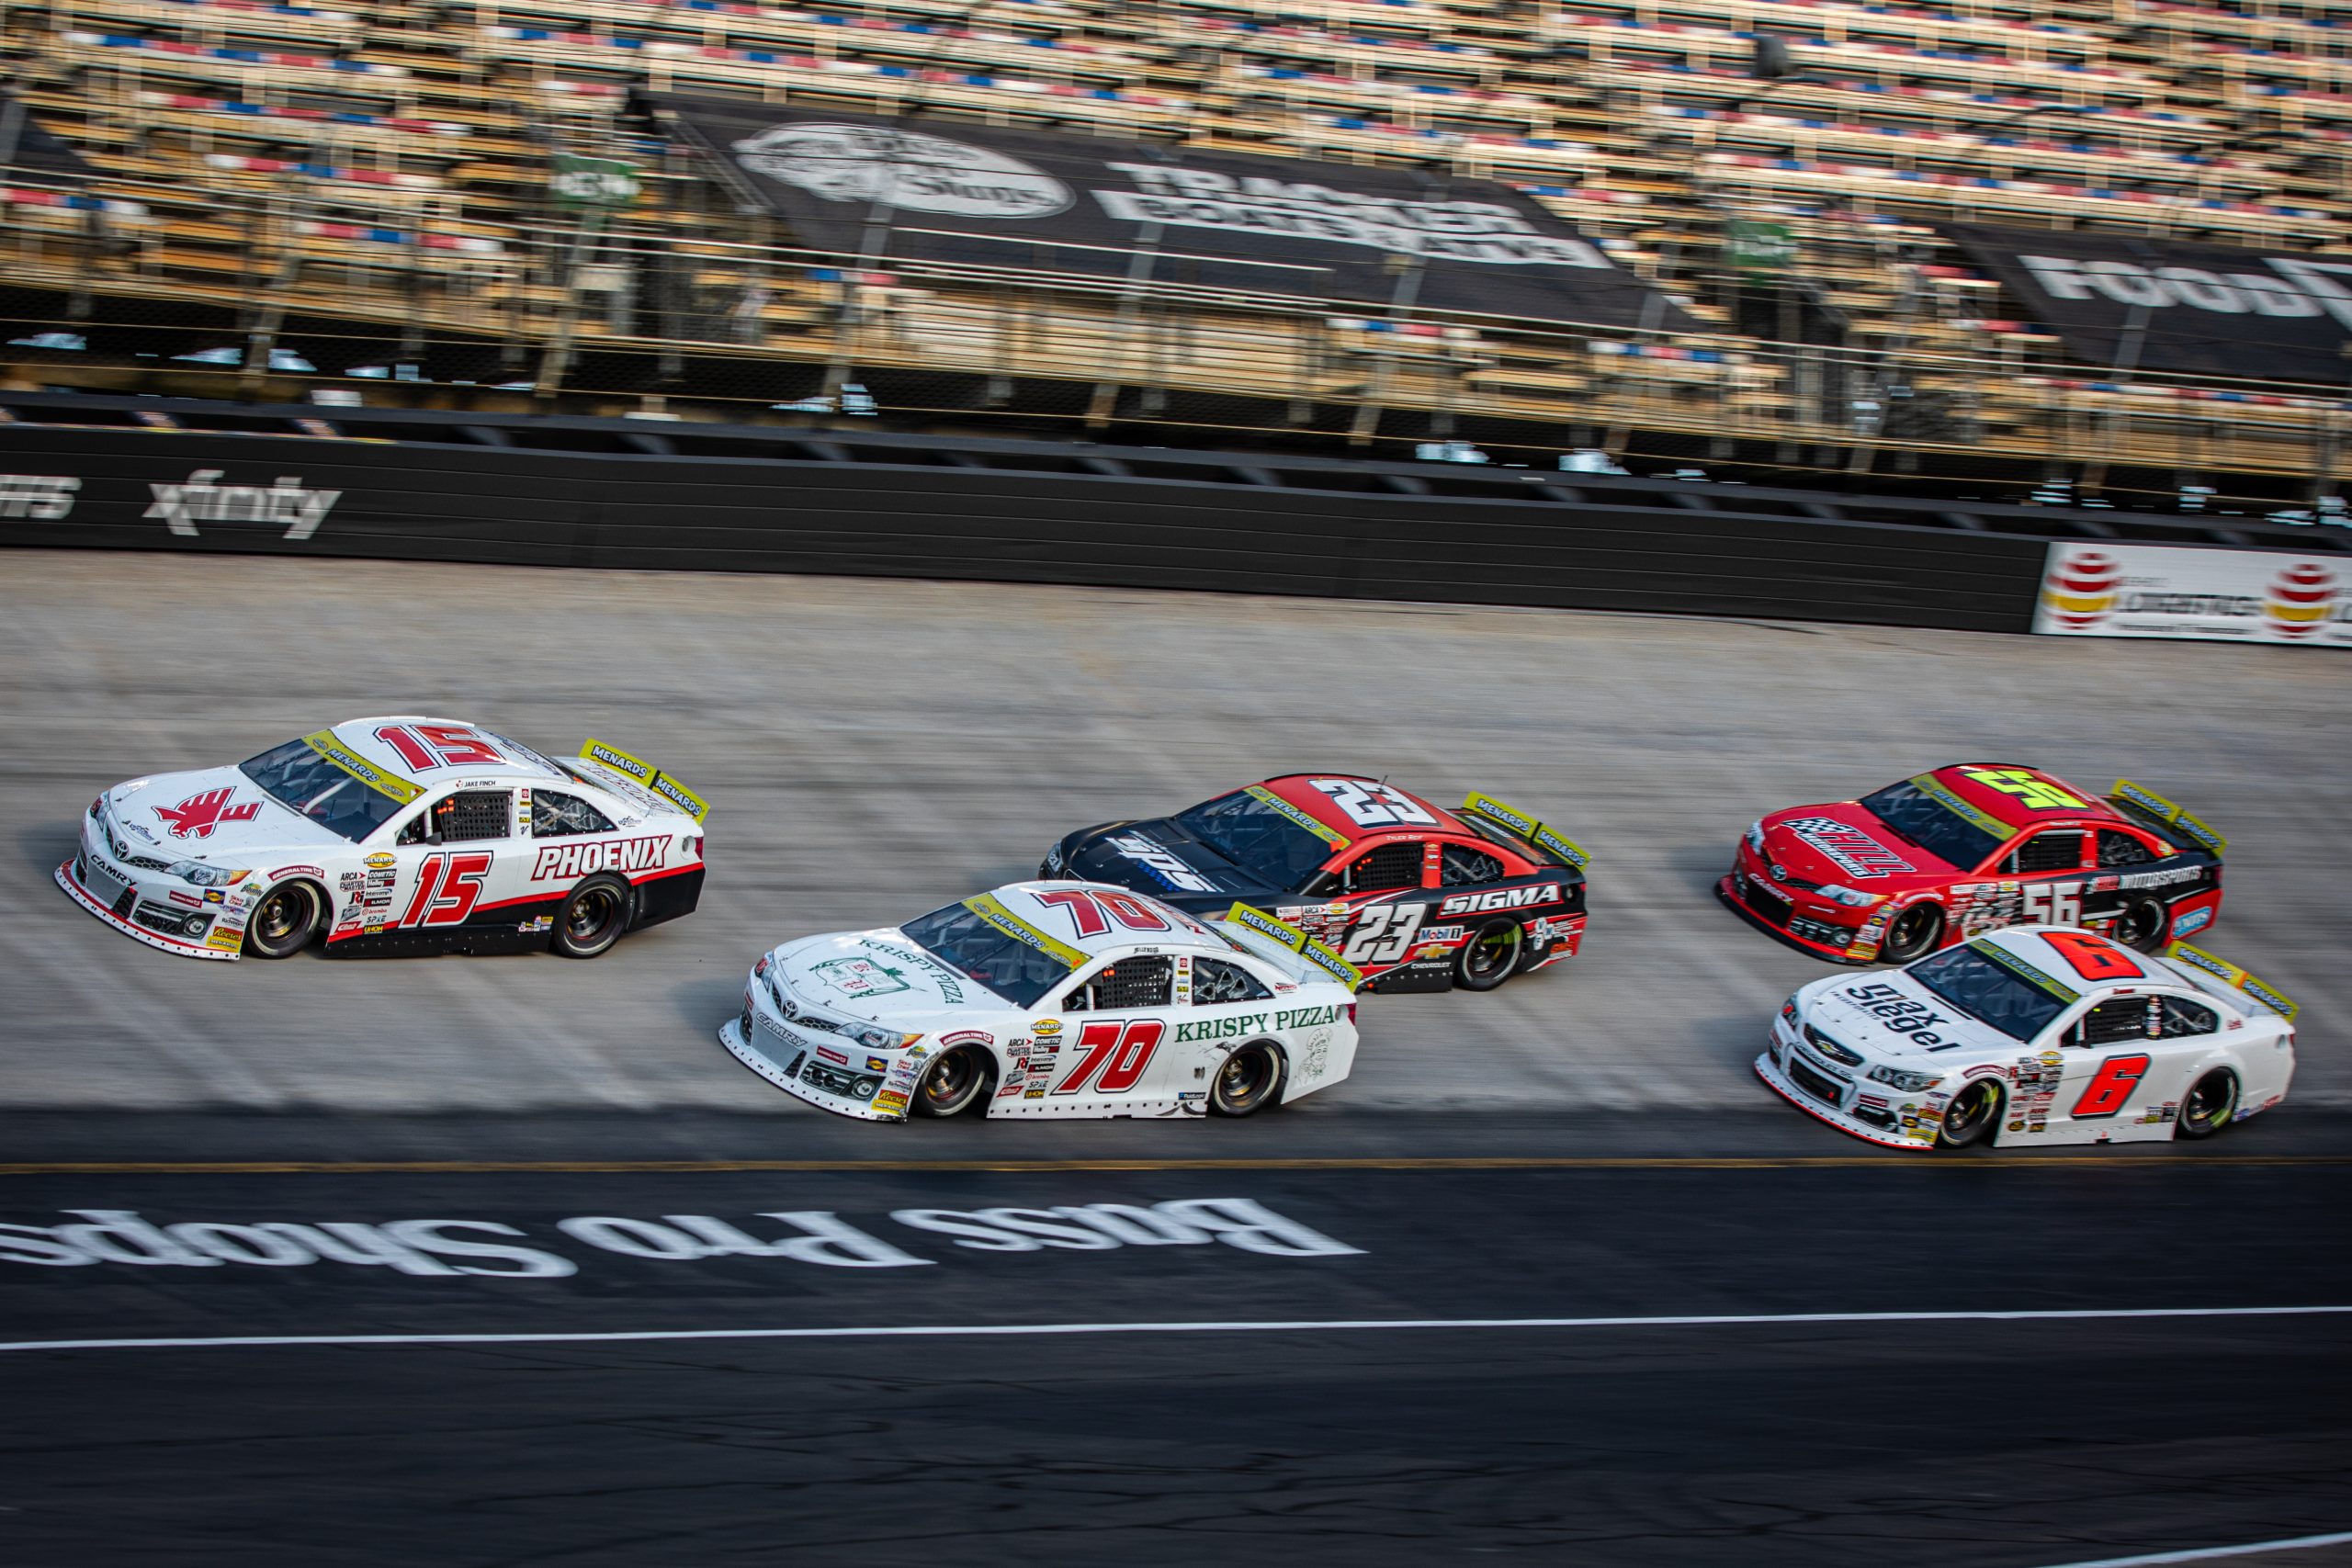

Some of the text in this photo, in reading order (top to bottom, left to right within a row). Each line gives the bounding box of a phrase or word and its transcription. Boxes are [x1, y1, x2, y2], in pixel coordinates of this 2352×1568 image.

[2017, 255, 2324, 317] FOOD
[141, 469, 343, 539] xfinity
[327, 749, 380, 783] MENARDS
[373, 725, 505, 773] 15
[592, 745, 648, 778] MENARDS
[655, 777, 702, 817] MENARDS
[1267, 797, 1319, 829] MENARDS
[1306, 779, 1442, 829] 23
[1476, 798, 1530, 831] MENARDS
[530, 834, 674, 881] PHOENIX
[1538, 830, 1585, 866] MENARDS
[91, 854, 138, 887] CAMRY
[272, 867, 300, 879] GENERAL
[341, 873, 357, 881] ARCA
[398, 851, 493, 929] 15
[1440, 885, 1560, 917] SIGMA
[2023, 881, 2083, 928] 56
[988, 912, 1045, 949] MENARDS
[1030, 889, 1172, 940] 70
[1239, 910, 1297, 945] MENARDS
[1341, 901, 1430, 963] 23
[1419, 928, 1449, 941] Mobil
[858, 939, 965, 1004] KRISPY PIZZA
[1305, 944, 1354, 983] MENARDS
[1994, 951, 2049, 983] MENARDS
[2038, 931, 2147, 981] 6
[2177, 947, 2233, 979] MENARDS
[1862, 984, 1950, 1027] max
[2242, 979, 2294, 1015] MENARDS
[756, 1011, 808, 1046] CAMRY
[1008, 1039, 1023, 1047] ARCA
[1174, 1005, 1335, 1043] KRISPY PIZZA
[1048, 1018, 1167, 1096] 70
[2071, 1053, 2153, 1120] 6
[0, 1198, 1370, 1277] Bass Pro Shops
